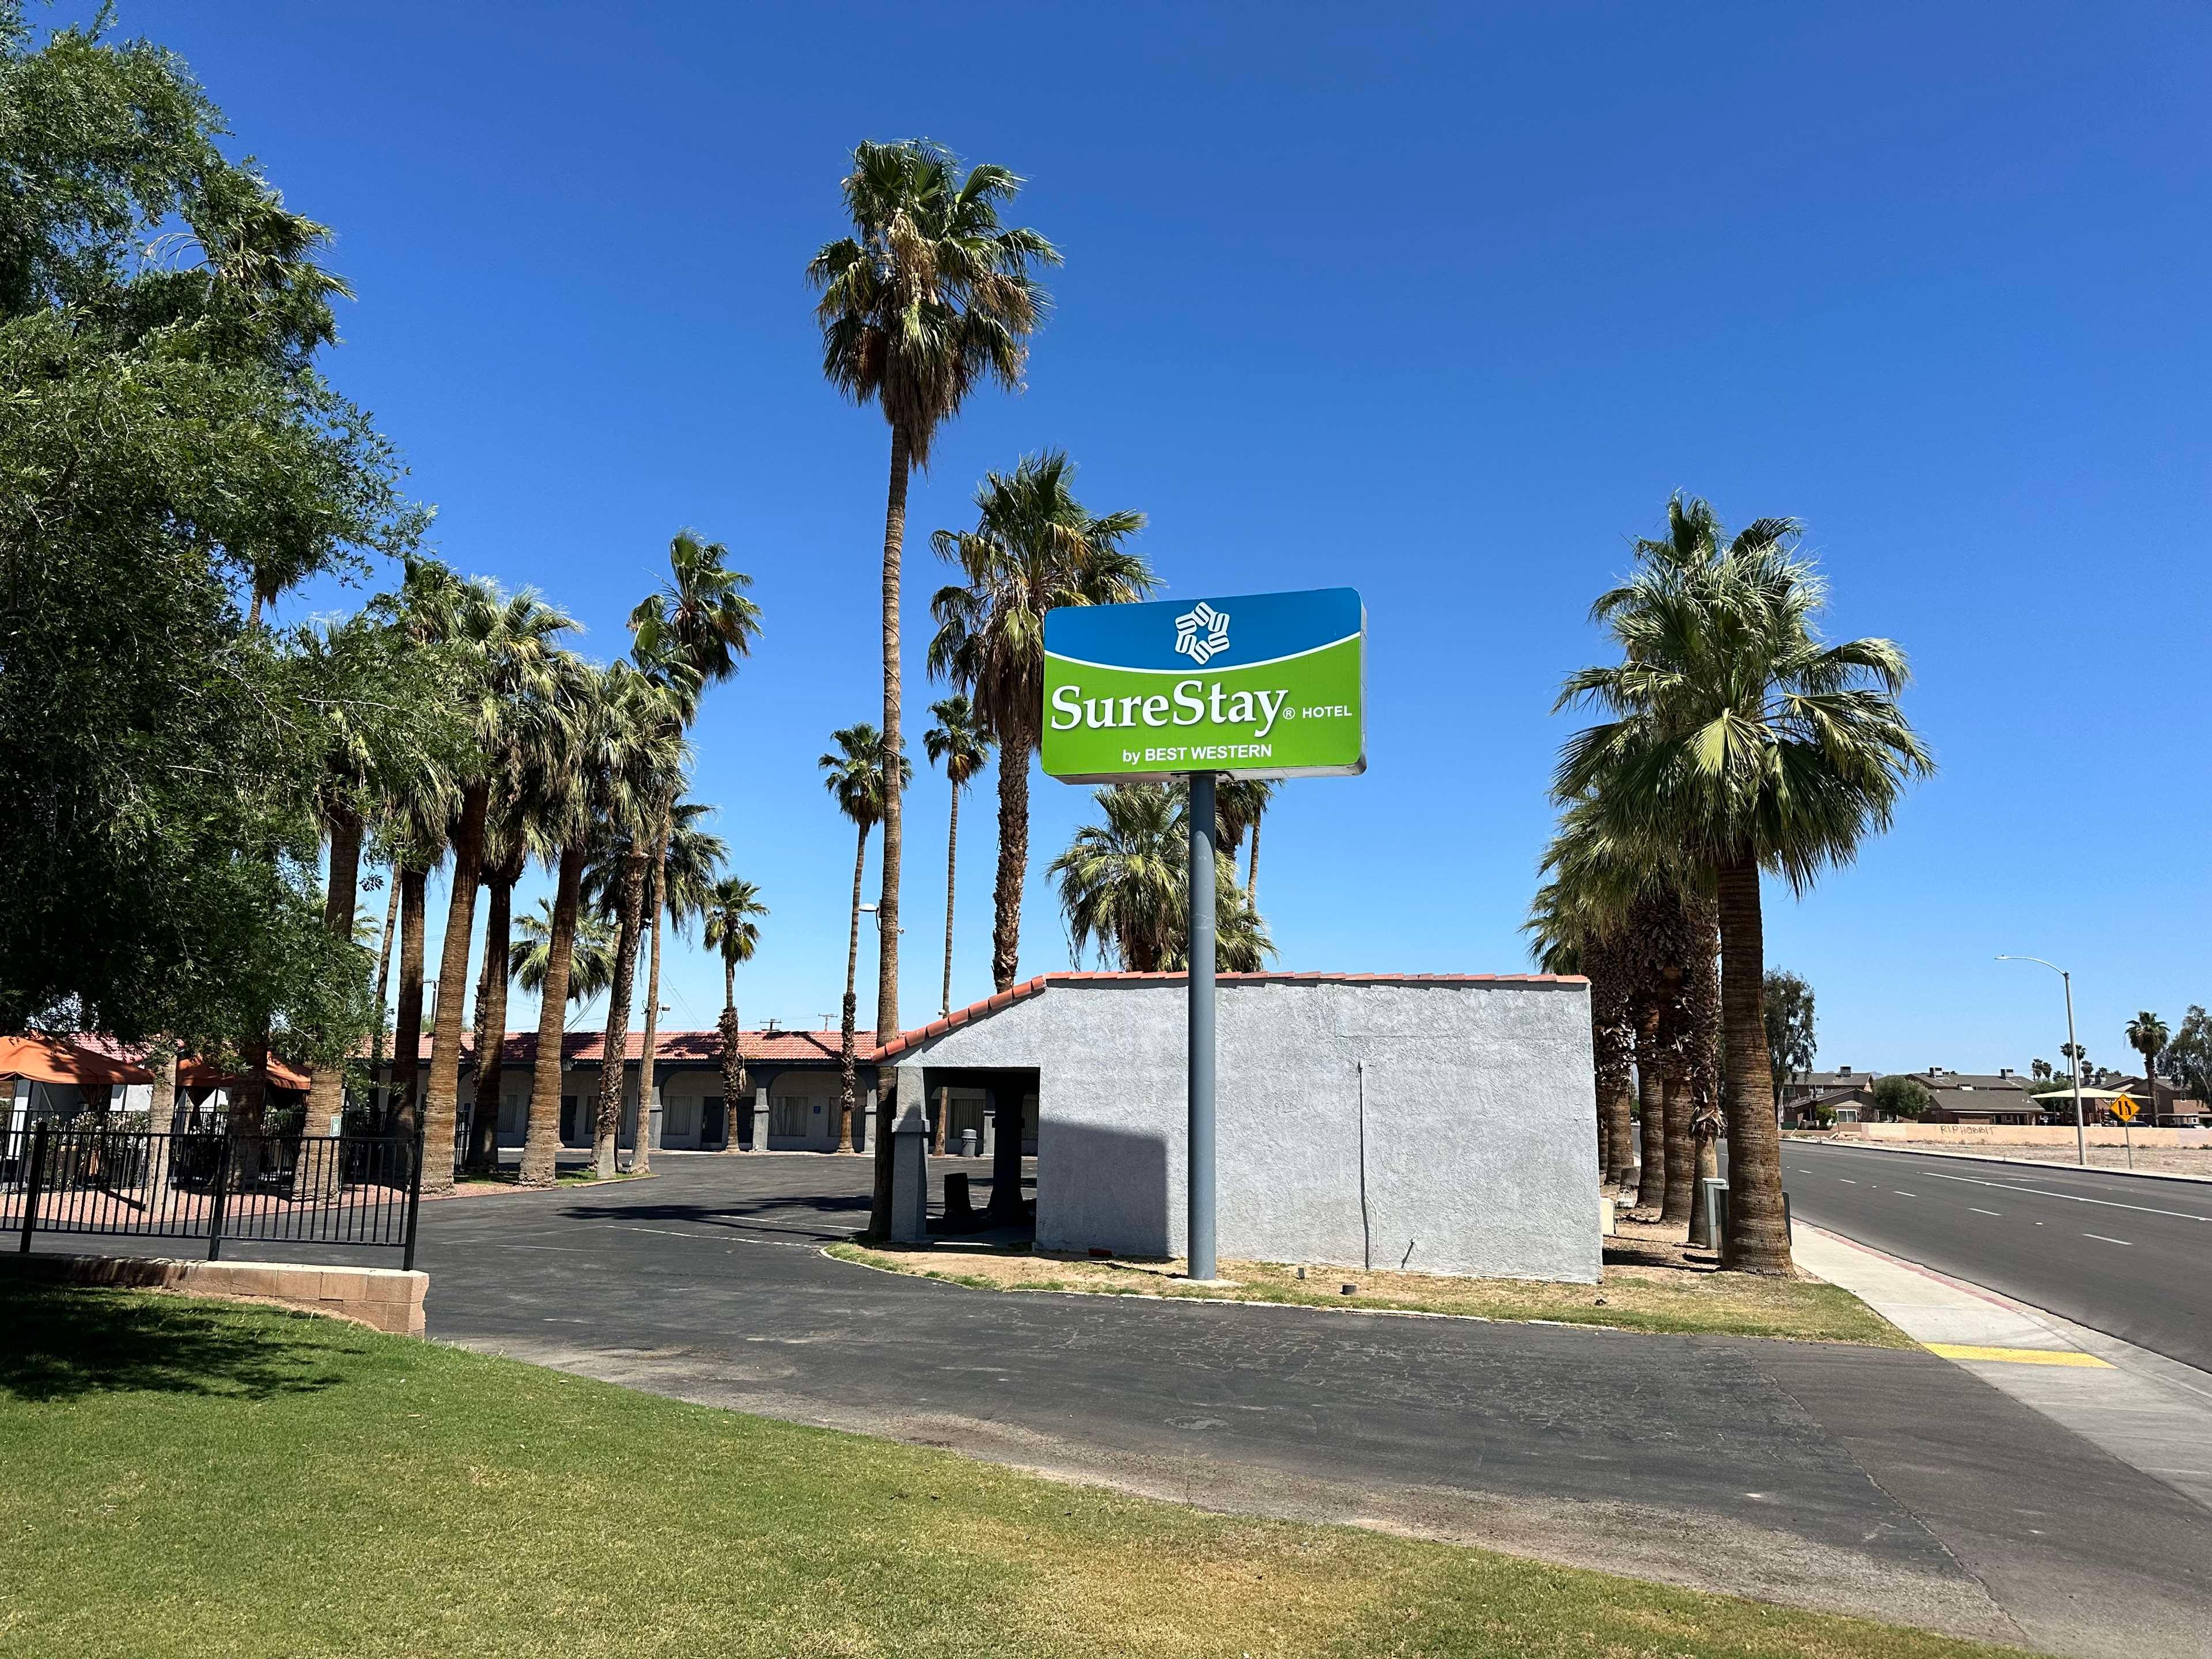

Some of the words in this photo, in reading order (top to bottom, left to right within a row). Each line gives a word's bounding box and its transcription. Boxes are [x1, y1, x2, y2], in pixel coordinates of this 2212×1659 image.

[1302, 705, 1352, 718] HOTEL
[1123, 749, 1141, 765] by
[1145, 747, 1187, 761] BEST
[1191, 744, 1272, 760] WESTERN
[1940, 1125, 1958, 1134] RIP
